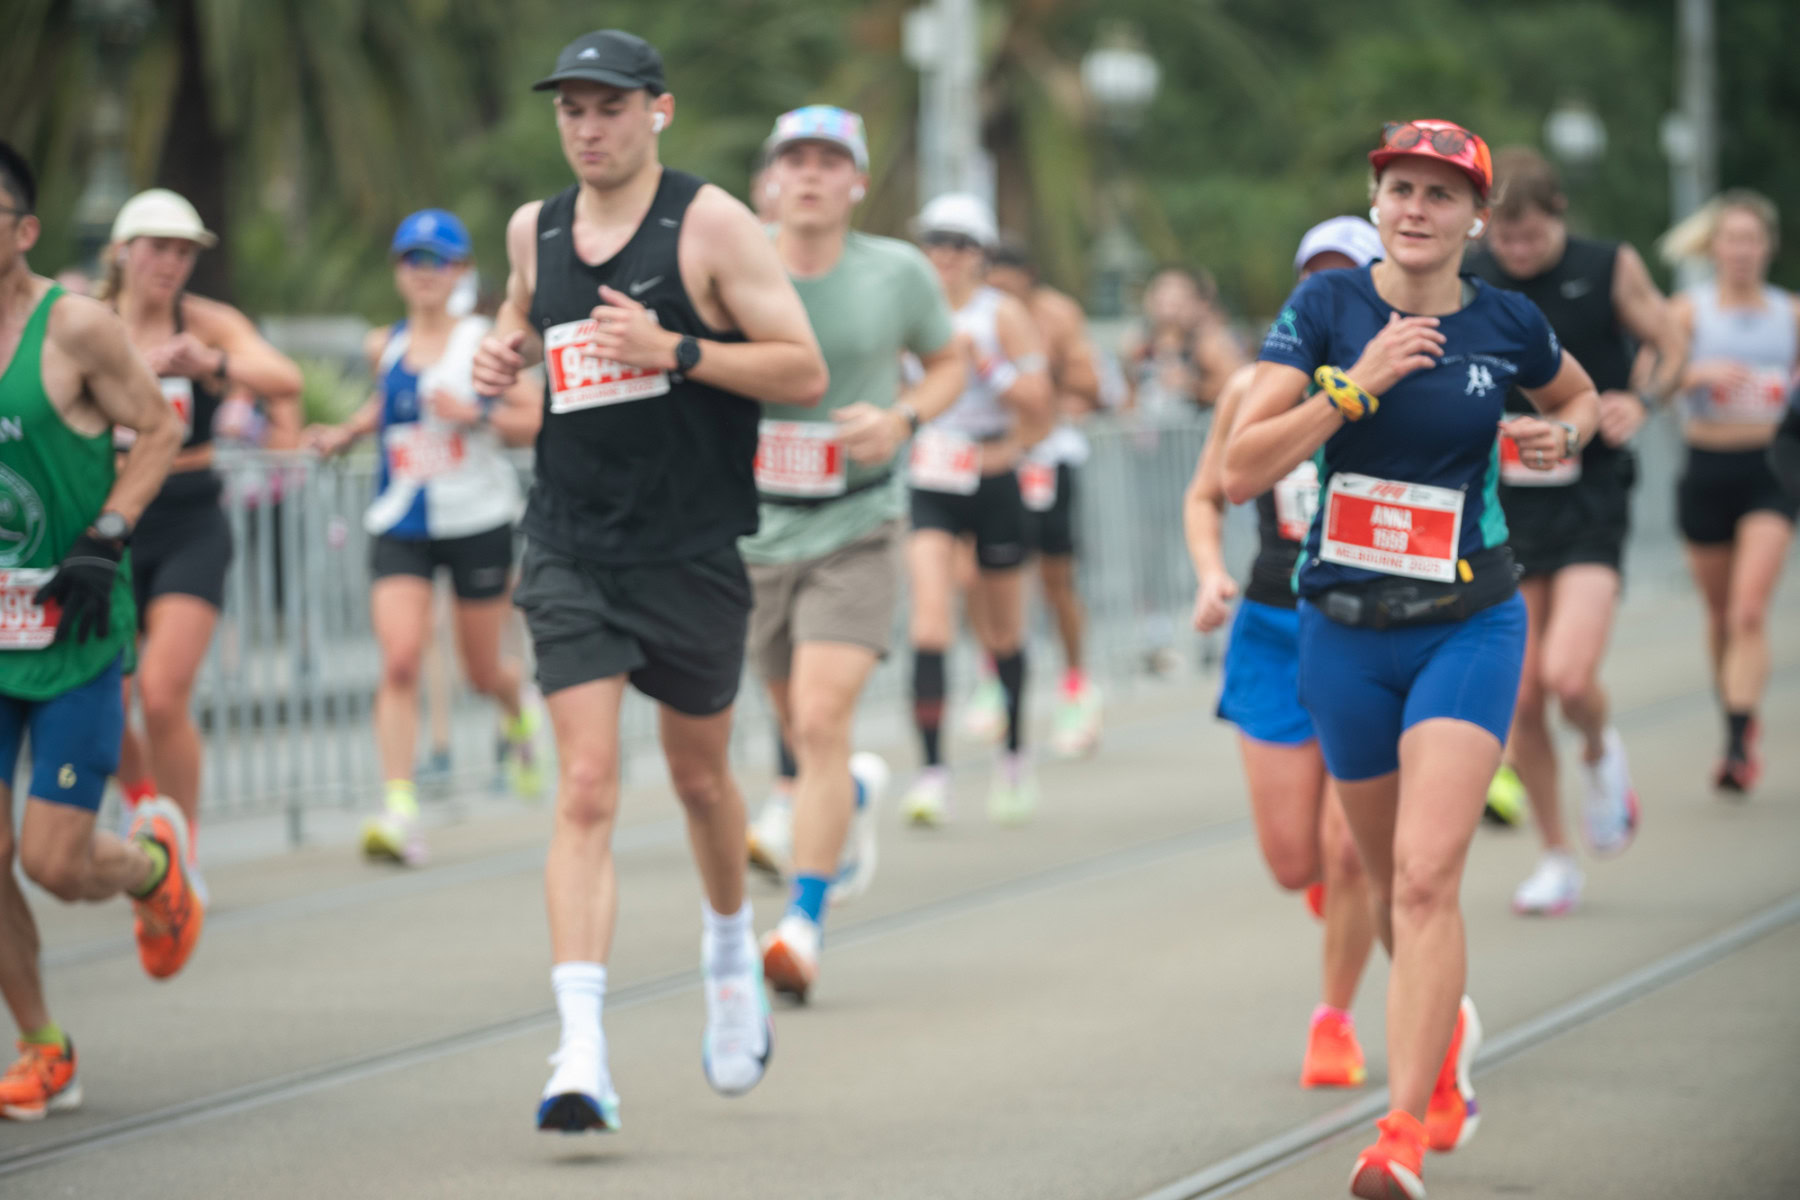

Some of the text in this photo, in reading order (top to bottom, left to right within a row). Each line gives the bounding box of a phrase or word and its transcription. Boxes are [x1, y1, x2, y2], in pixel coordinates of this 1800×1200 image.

[561, 343, 641, 387] 944
[1370, 504, 1412, 531] ANNA
[1335, 546, 1404, 569] MELBOURNE
[0, 590, 45, 626] 95
